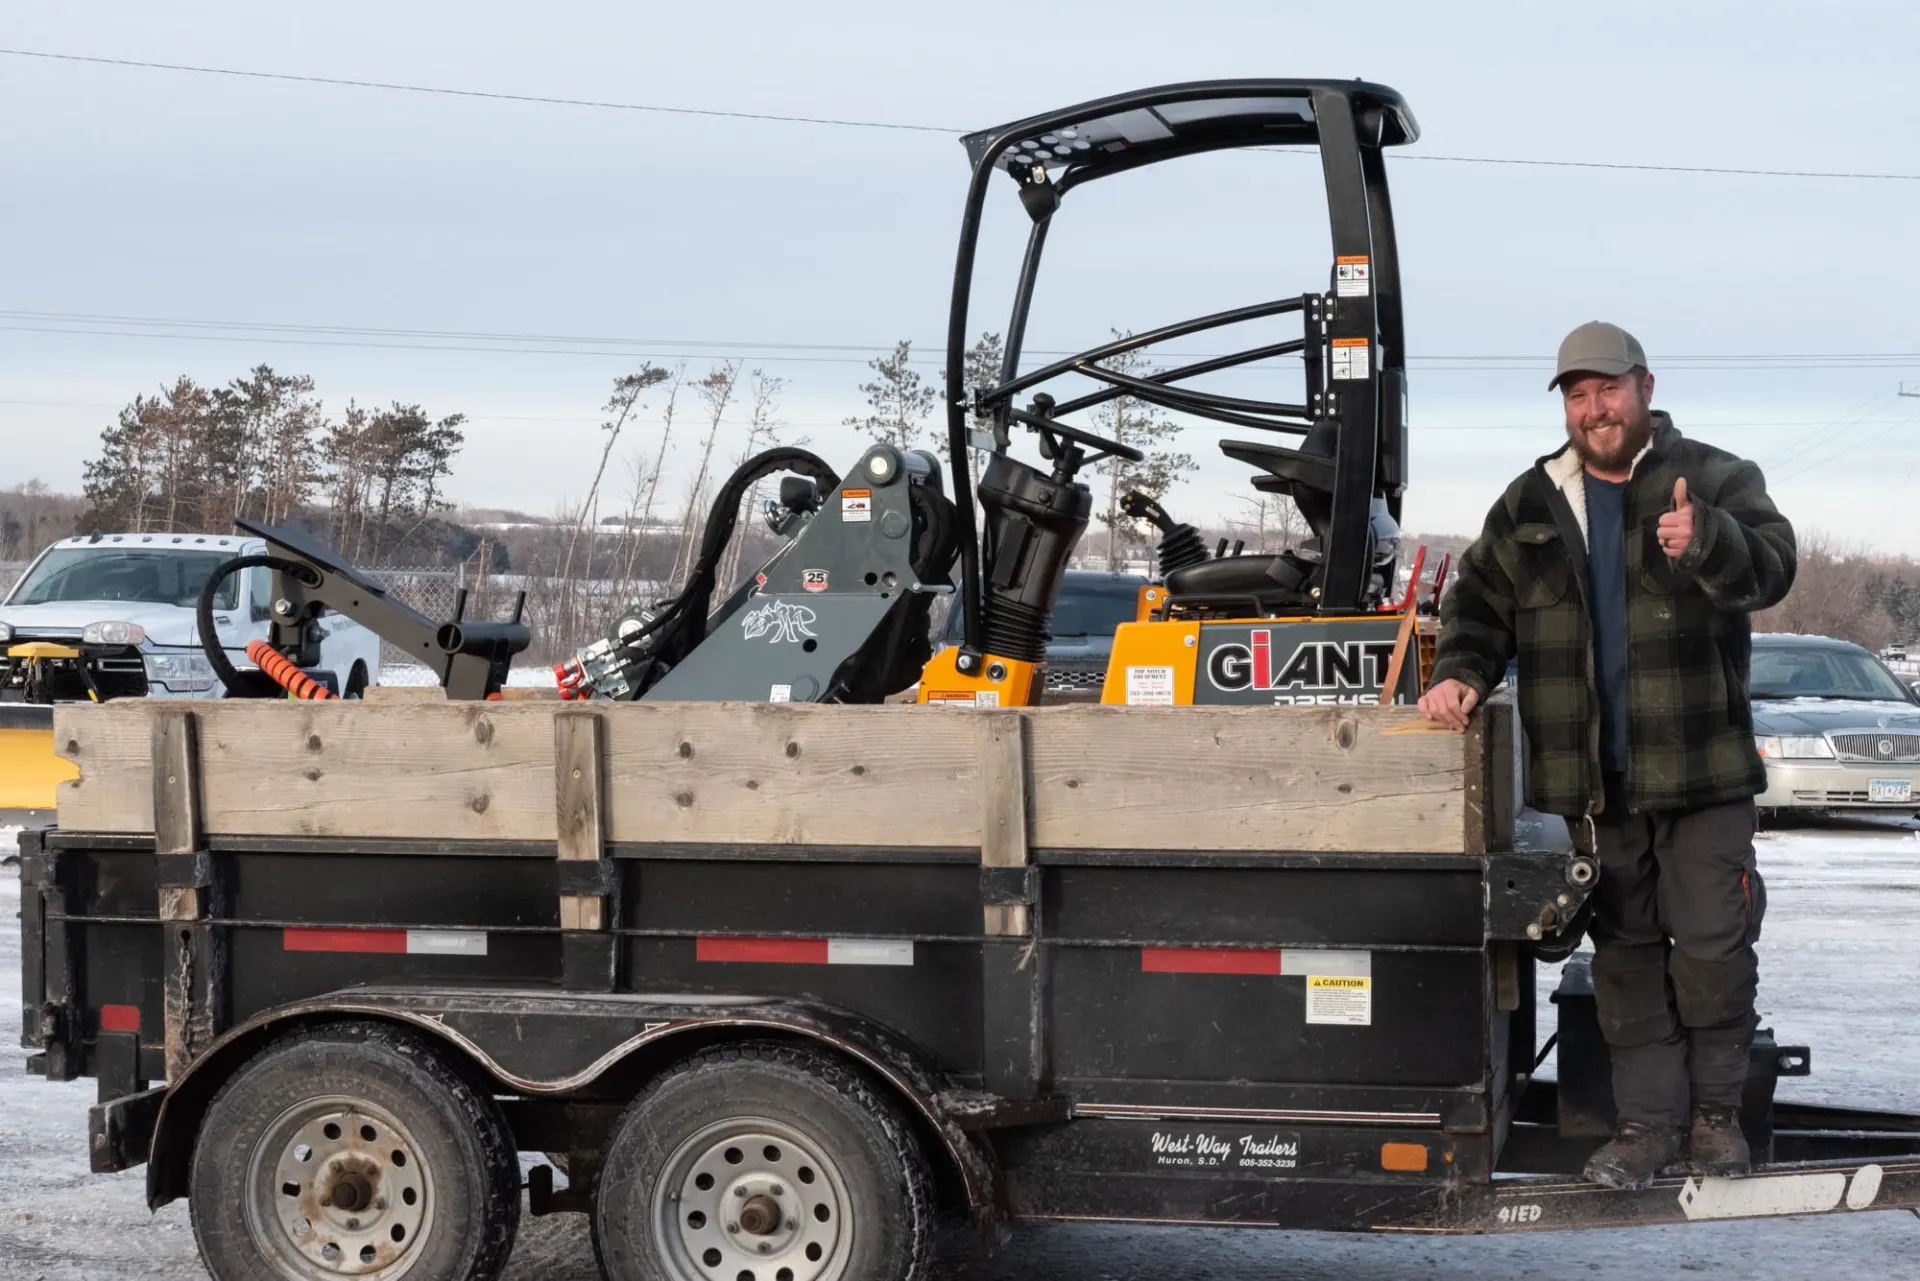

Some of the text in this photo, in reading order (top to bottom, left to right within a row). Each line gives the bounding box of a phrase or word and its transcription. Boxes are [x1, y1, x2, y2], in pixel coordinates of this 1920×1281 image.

[807, 573, 825, 583] 25
[1322, 979, 1364, 987] CAUTION
[1151, 1132, 1298, 1161] West-Way Trailers
[1197, 1157, 1220, 1166] S.D.
[1239, 1158, 1296, 1168] 605-352-3236
